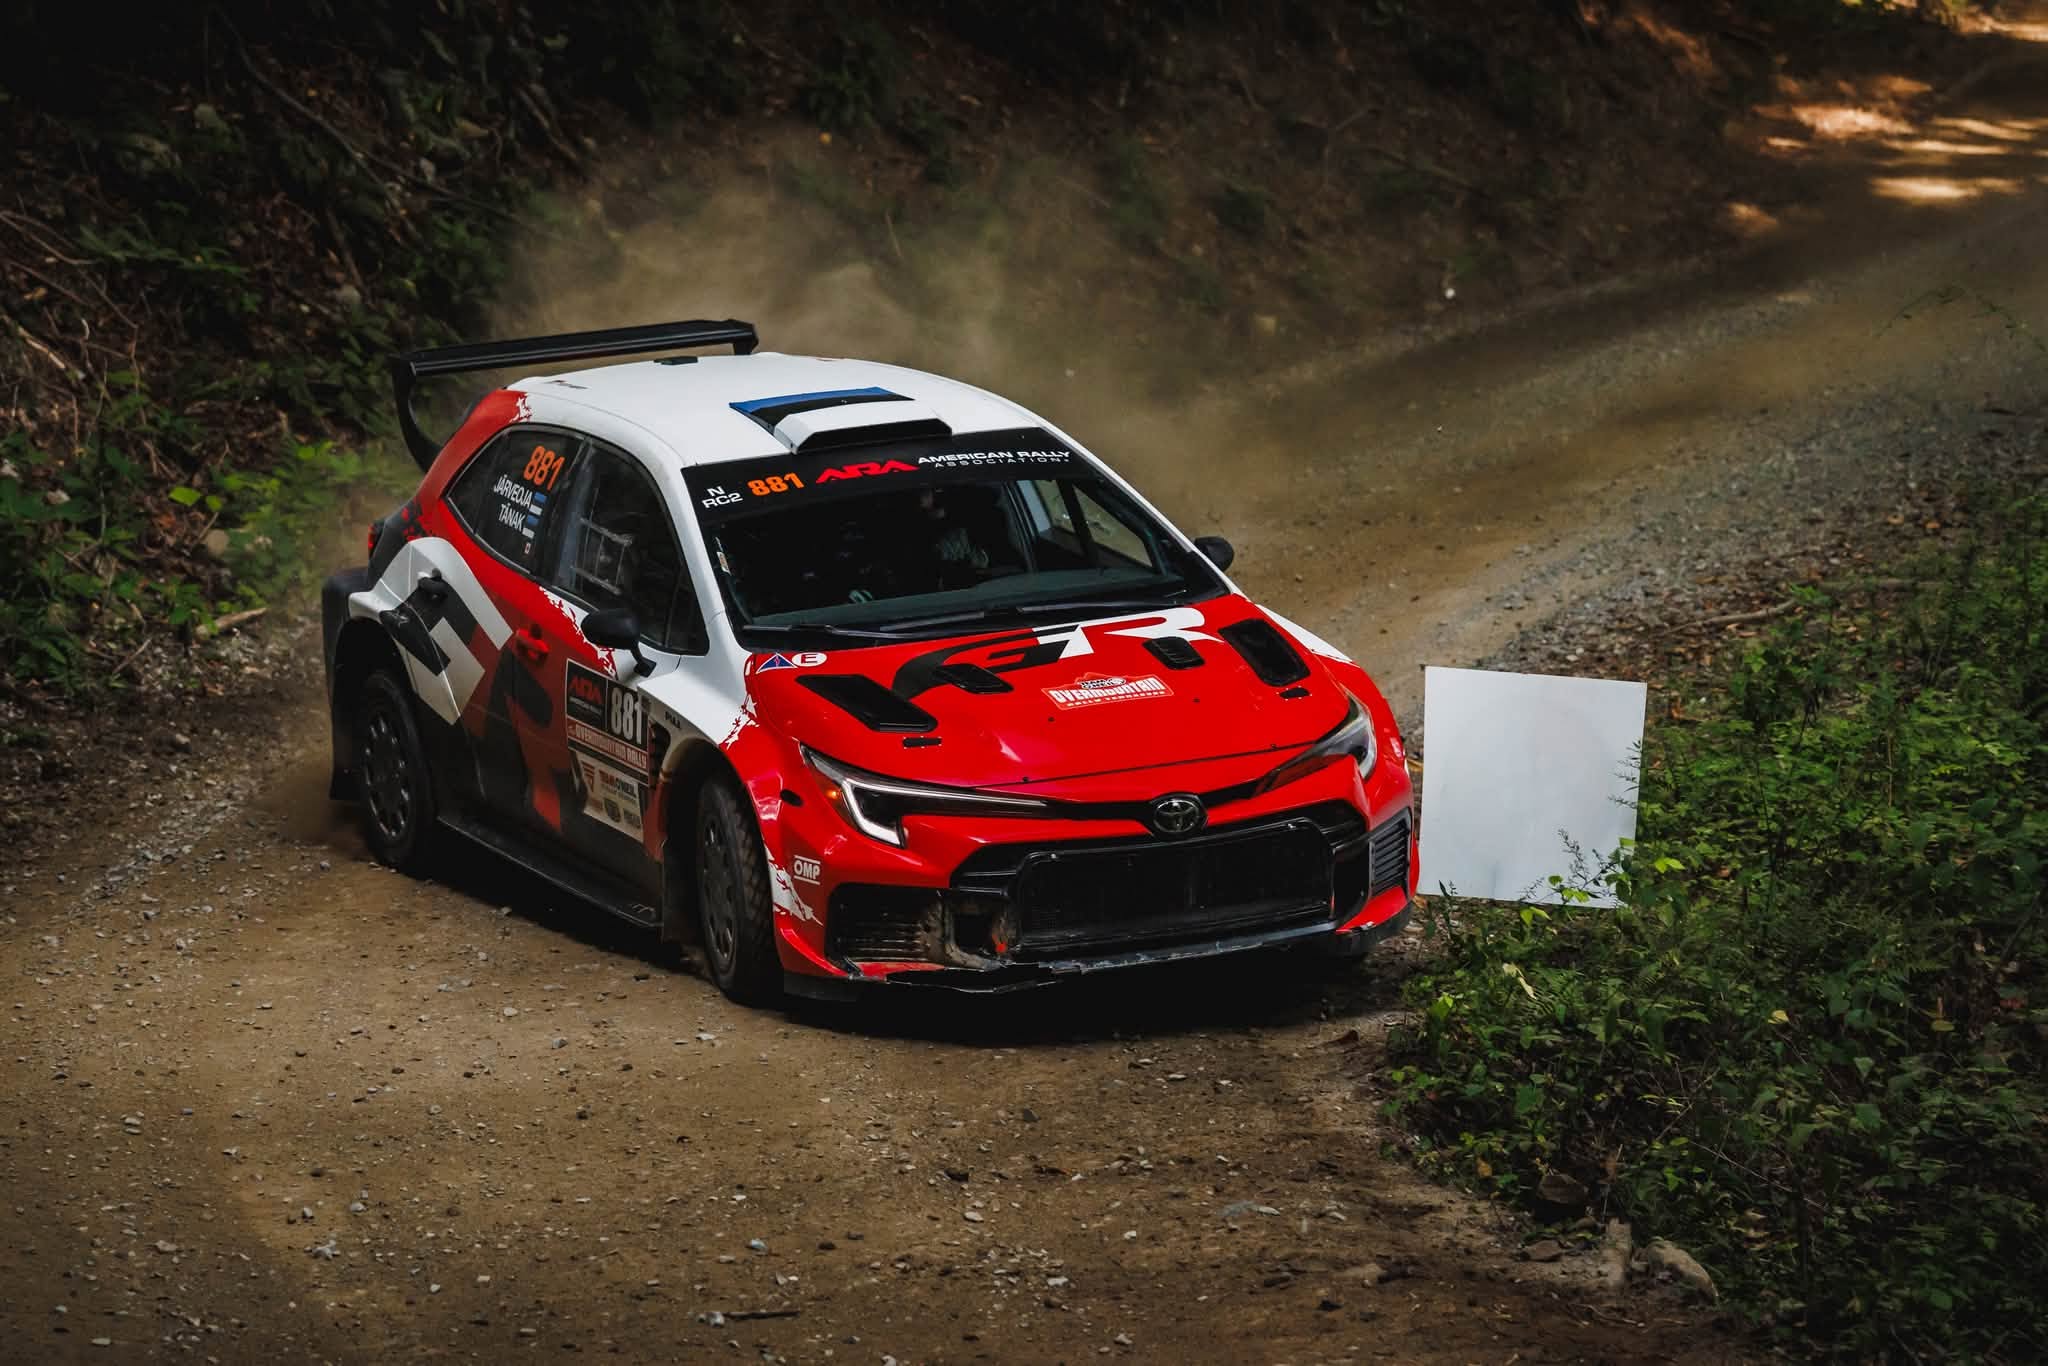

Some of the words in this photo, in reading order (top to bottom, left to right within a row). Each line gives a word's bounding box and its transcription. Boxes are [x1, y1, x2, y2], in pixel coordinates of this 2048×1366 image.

[523, 445, 565, 491] 881
[918, 451, 1013, 464] AMERICAN
[935, 457, 1061, 468] ASSOCIATION
[815, 459, 920, 484] ARA
[493, 474, 533, 508] JÄRVEOJA
[707, 486, 725, 497] N
[747, 472, 804, 496] 881
[702, 492, 743, 508] RC2
[499, 502, 525, 532] TÄNAK
[568, 675, 603, 705] ARA
[611, 687, 642, 744] 881
[793, 860, 820, 880] OMP
